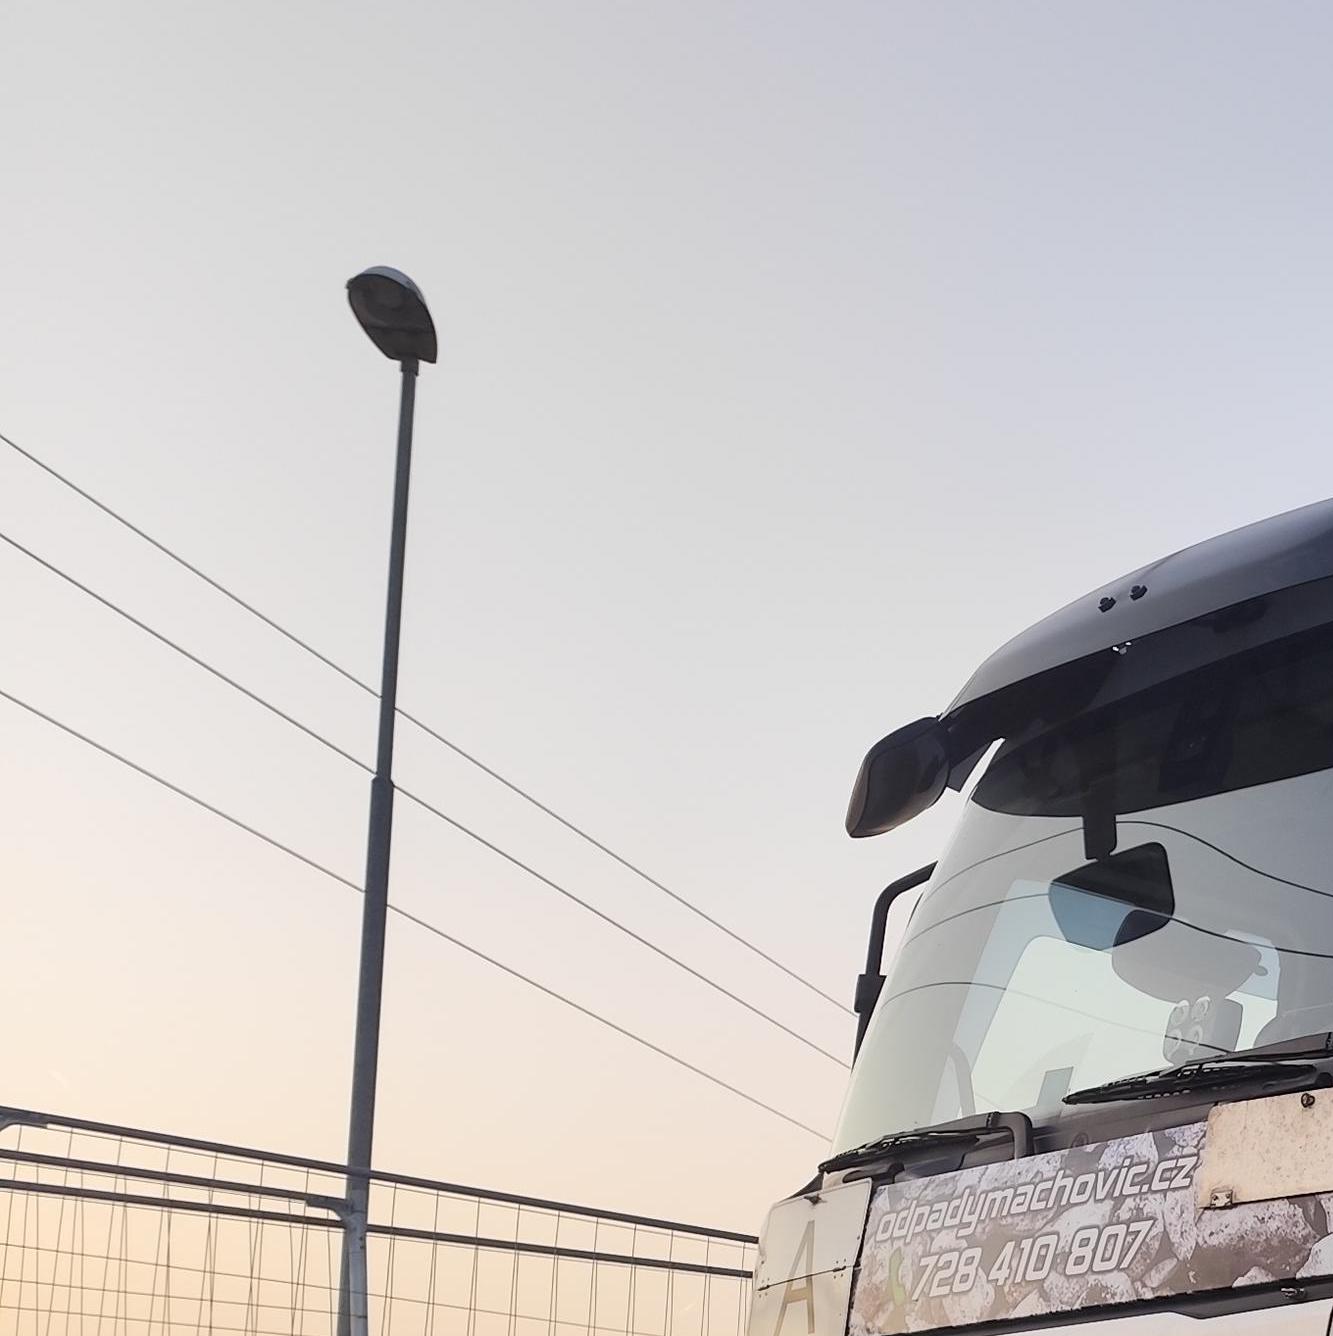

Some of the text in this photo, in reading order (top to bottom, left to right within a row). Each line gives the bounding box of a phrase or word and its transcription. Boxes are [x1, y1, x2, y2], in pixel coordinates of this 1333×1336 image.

[876, 1154, 1197, 1243] odpadymachovic.cz
[911, 1219, 1155, 1300] 728 410 807
